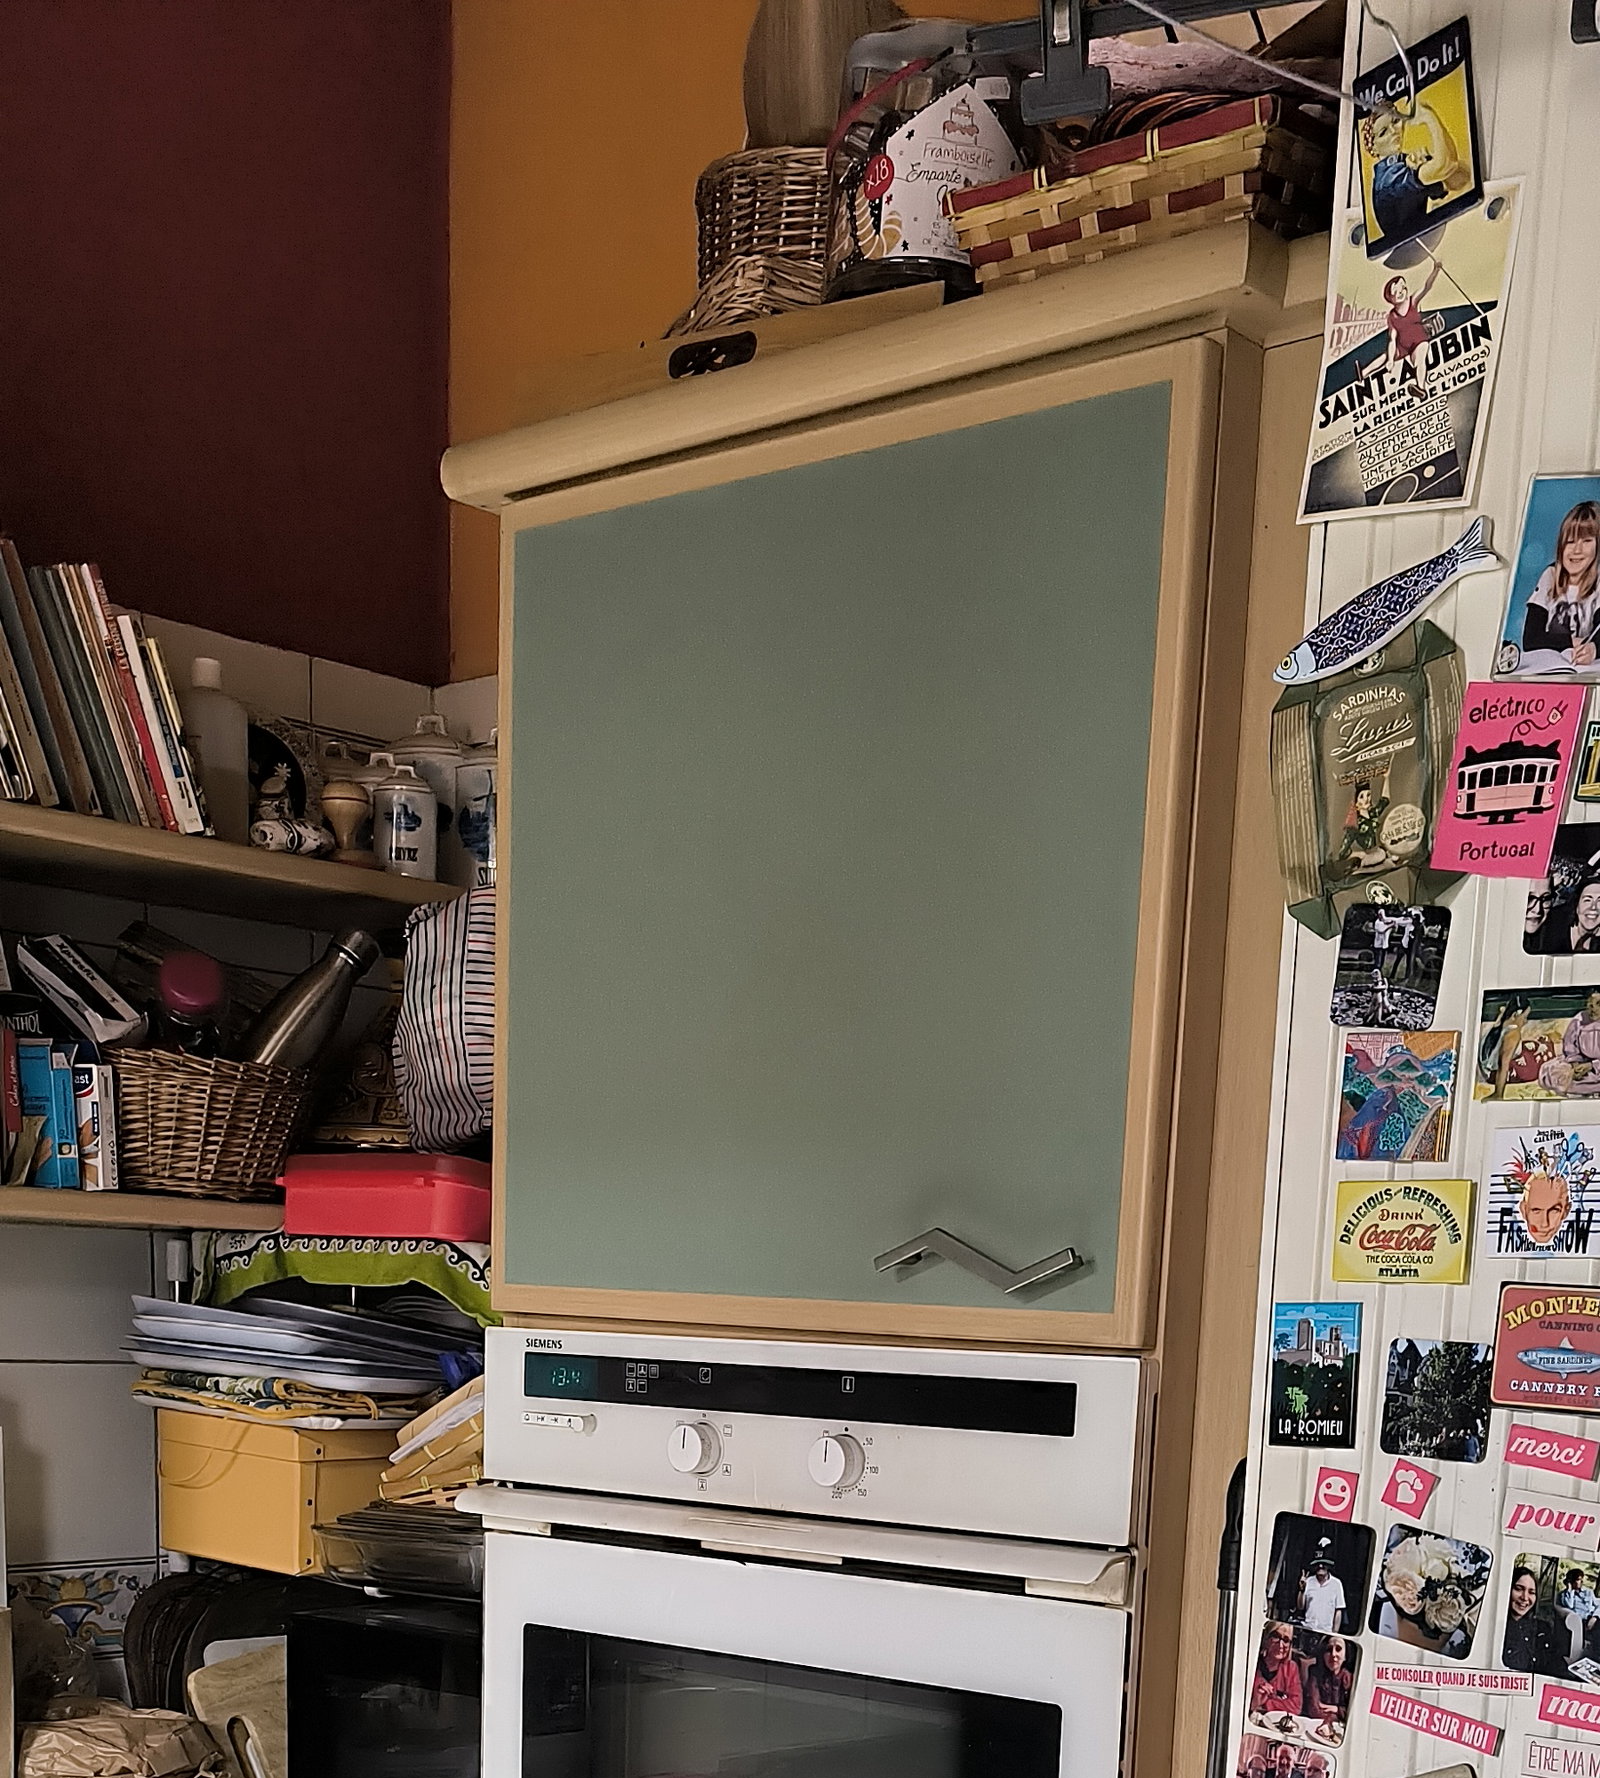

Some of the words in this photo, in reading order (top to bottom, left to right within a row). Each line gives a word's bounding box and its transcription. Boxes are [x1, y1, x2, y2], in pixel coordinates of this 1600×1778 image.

[1358, 85, 1384, 110] We
[1417, 56, 1439, 81] Do
[1442, 36, 1461, 66] It!
[922, 141, 995, 169] Framboiselle
[866, 158, 889, 191] x18
[1426, 345, 1491, 386] (CALVADOS)
[1352, 402, 1377, 423] SUR
[1379, 387, 1407, 410] MER
[1353, 422, 1371, 437] LA
[1373, 398, 1416, 427] REINE
[1441, 362, 1487, 393] L'IODE
[1407, 398, 1448, 423] PARIS
[1374, 426, 1417, 453] CENTRE
[1389, 440, 1433, 468] PLAGE
[1332, 686, 1406, 722] SARDINHAS
[1469, 696, 1546, 724] eléctrico
[1459, 839, 1536, 863] Portugal
[3, 1013, 43, 1034] NTHOL
[1339, 1187, 1393, 1246] DELICIOUS
[1402, 1185, 1462, 1245] REFRESHING
[1378, 1208, 1425, 1222] DRINK
[1552, 1208, 1596, 1254] SHOW
[1365, 1254, 1379, 1264] THE
[1380, 1254, 1401, 1264] COCA
[1402, 1255, 1421, 1265] COLA
[1378, 1267, 1420, 1278] ATLANTA
[1503, 1296, 1600, 1331] MONTE
[1538, 1320, 1594, 1332] CANNING
[525, 1337, 563, 1350] SIEMENS
[1538, 1355, 1555, 1365] FINE
[1556, 1356, 1593, 1365] SARDINES
[1509, 1379, 1588, 1397] CANNERY
[1298, 1419, 1343, 1436] ROMIEU
[1509, 1436, 1585, 1467] merci
[869, 1466, 879, 1475] 100
[857, 1488, 868, 1497] 150
[1505, 1504, 1596, 1534] pour
[1376, 1666, 1389, 1680] ME
[1391, 1667, 1434, 1684] CONSOLER
[1435, 1671, 1465, 1687] QUAND
[1466, 1673, 1477, 1687] JE
[1478, 1674, 1499, 1689] SUIS
[1500, 1675, 1529, 1691] TRISTE
[1379, 1692, 1430, 1730] VEILLER
[1430, 1711, 1460, 1739] SUR
[1461, 1721, 1490, 1750] MOI
[1528, 1740, 1560, 1772] ÊTRE
[1562, 1749, 1585, 1776] MA
